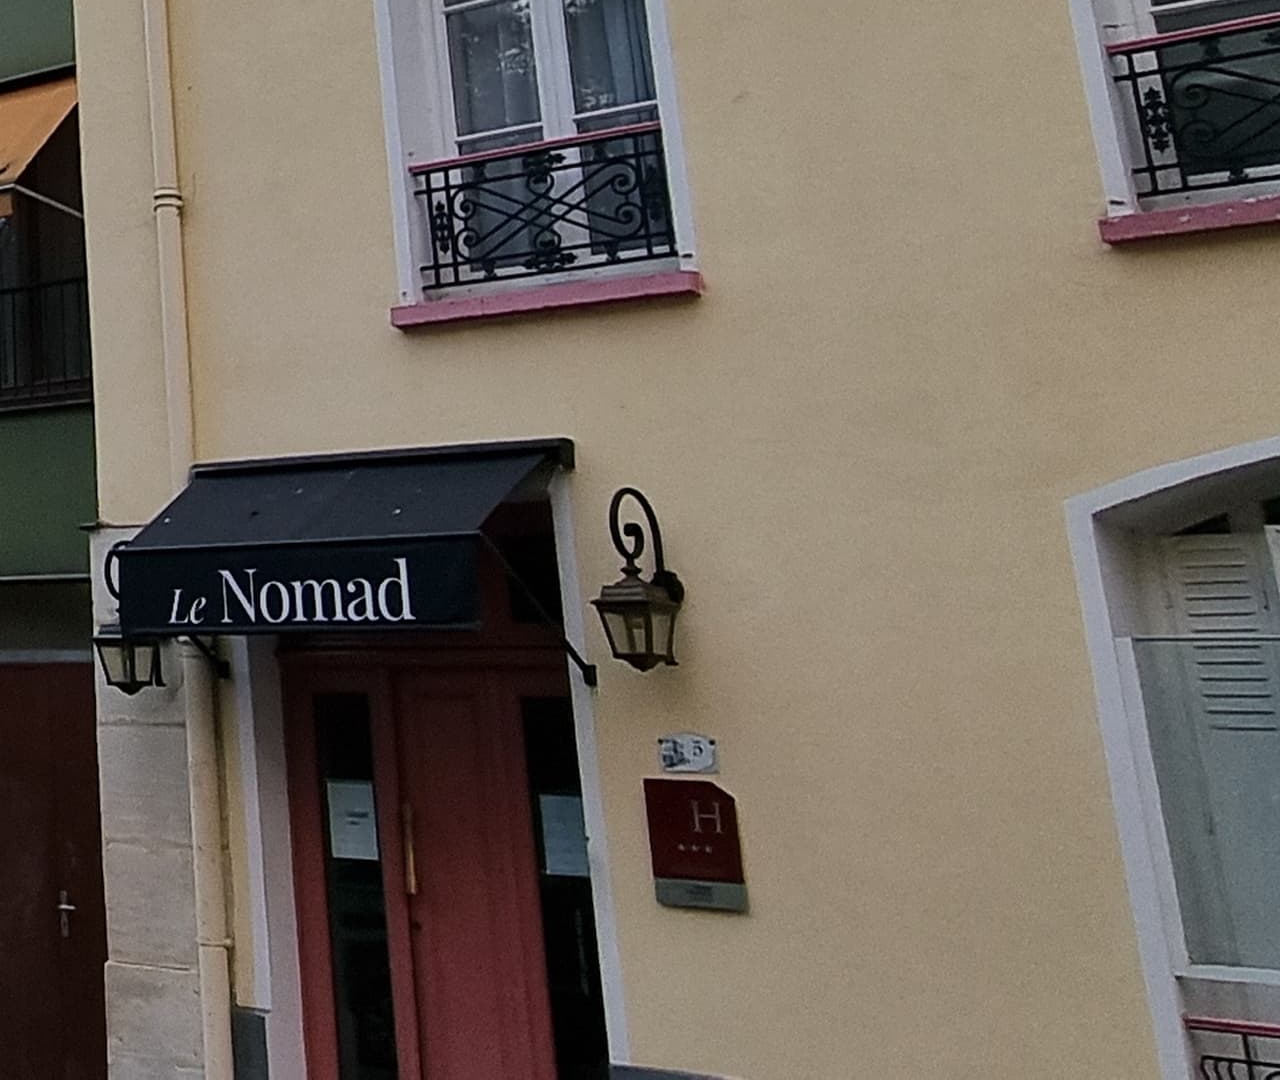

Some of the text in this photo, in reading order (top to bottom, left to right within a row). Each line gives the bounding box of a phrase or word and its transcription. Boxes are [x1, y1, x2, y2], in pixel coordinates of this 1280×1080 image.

[169, 558, 416, 624] Le Nomad
[690, 800, 722, 833] H
